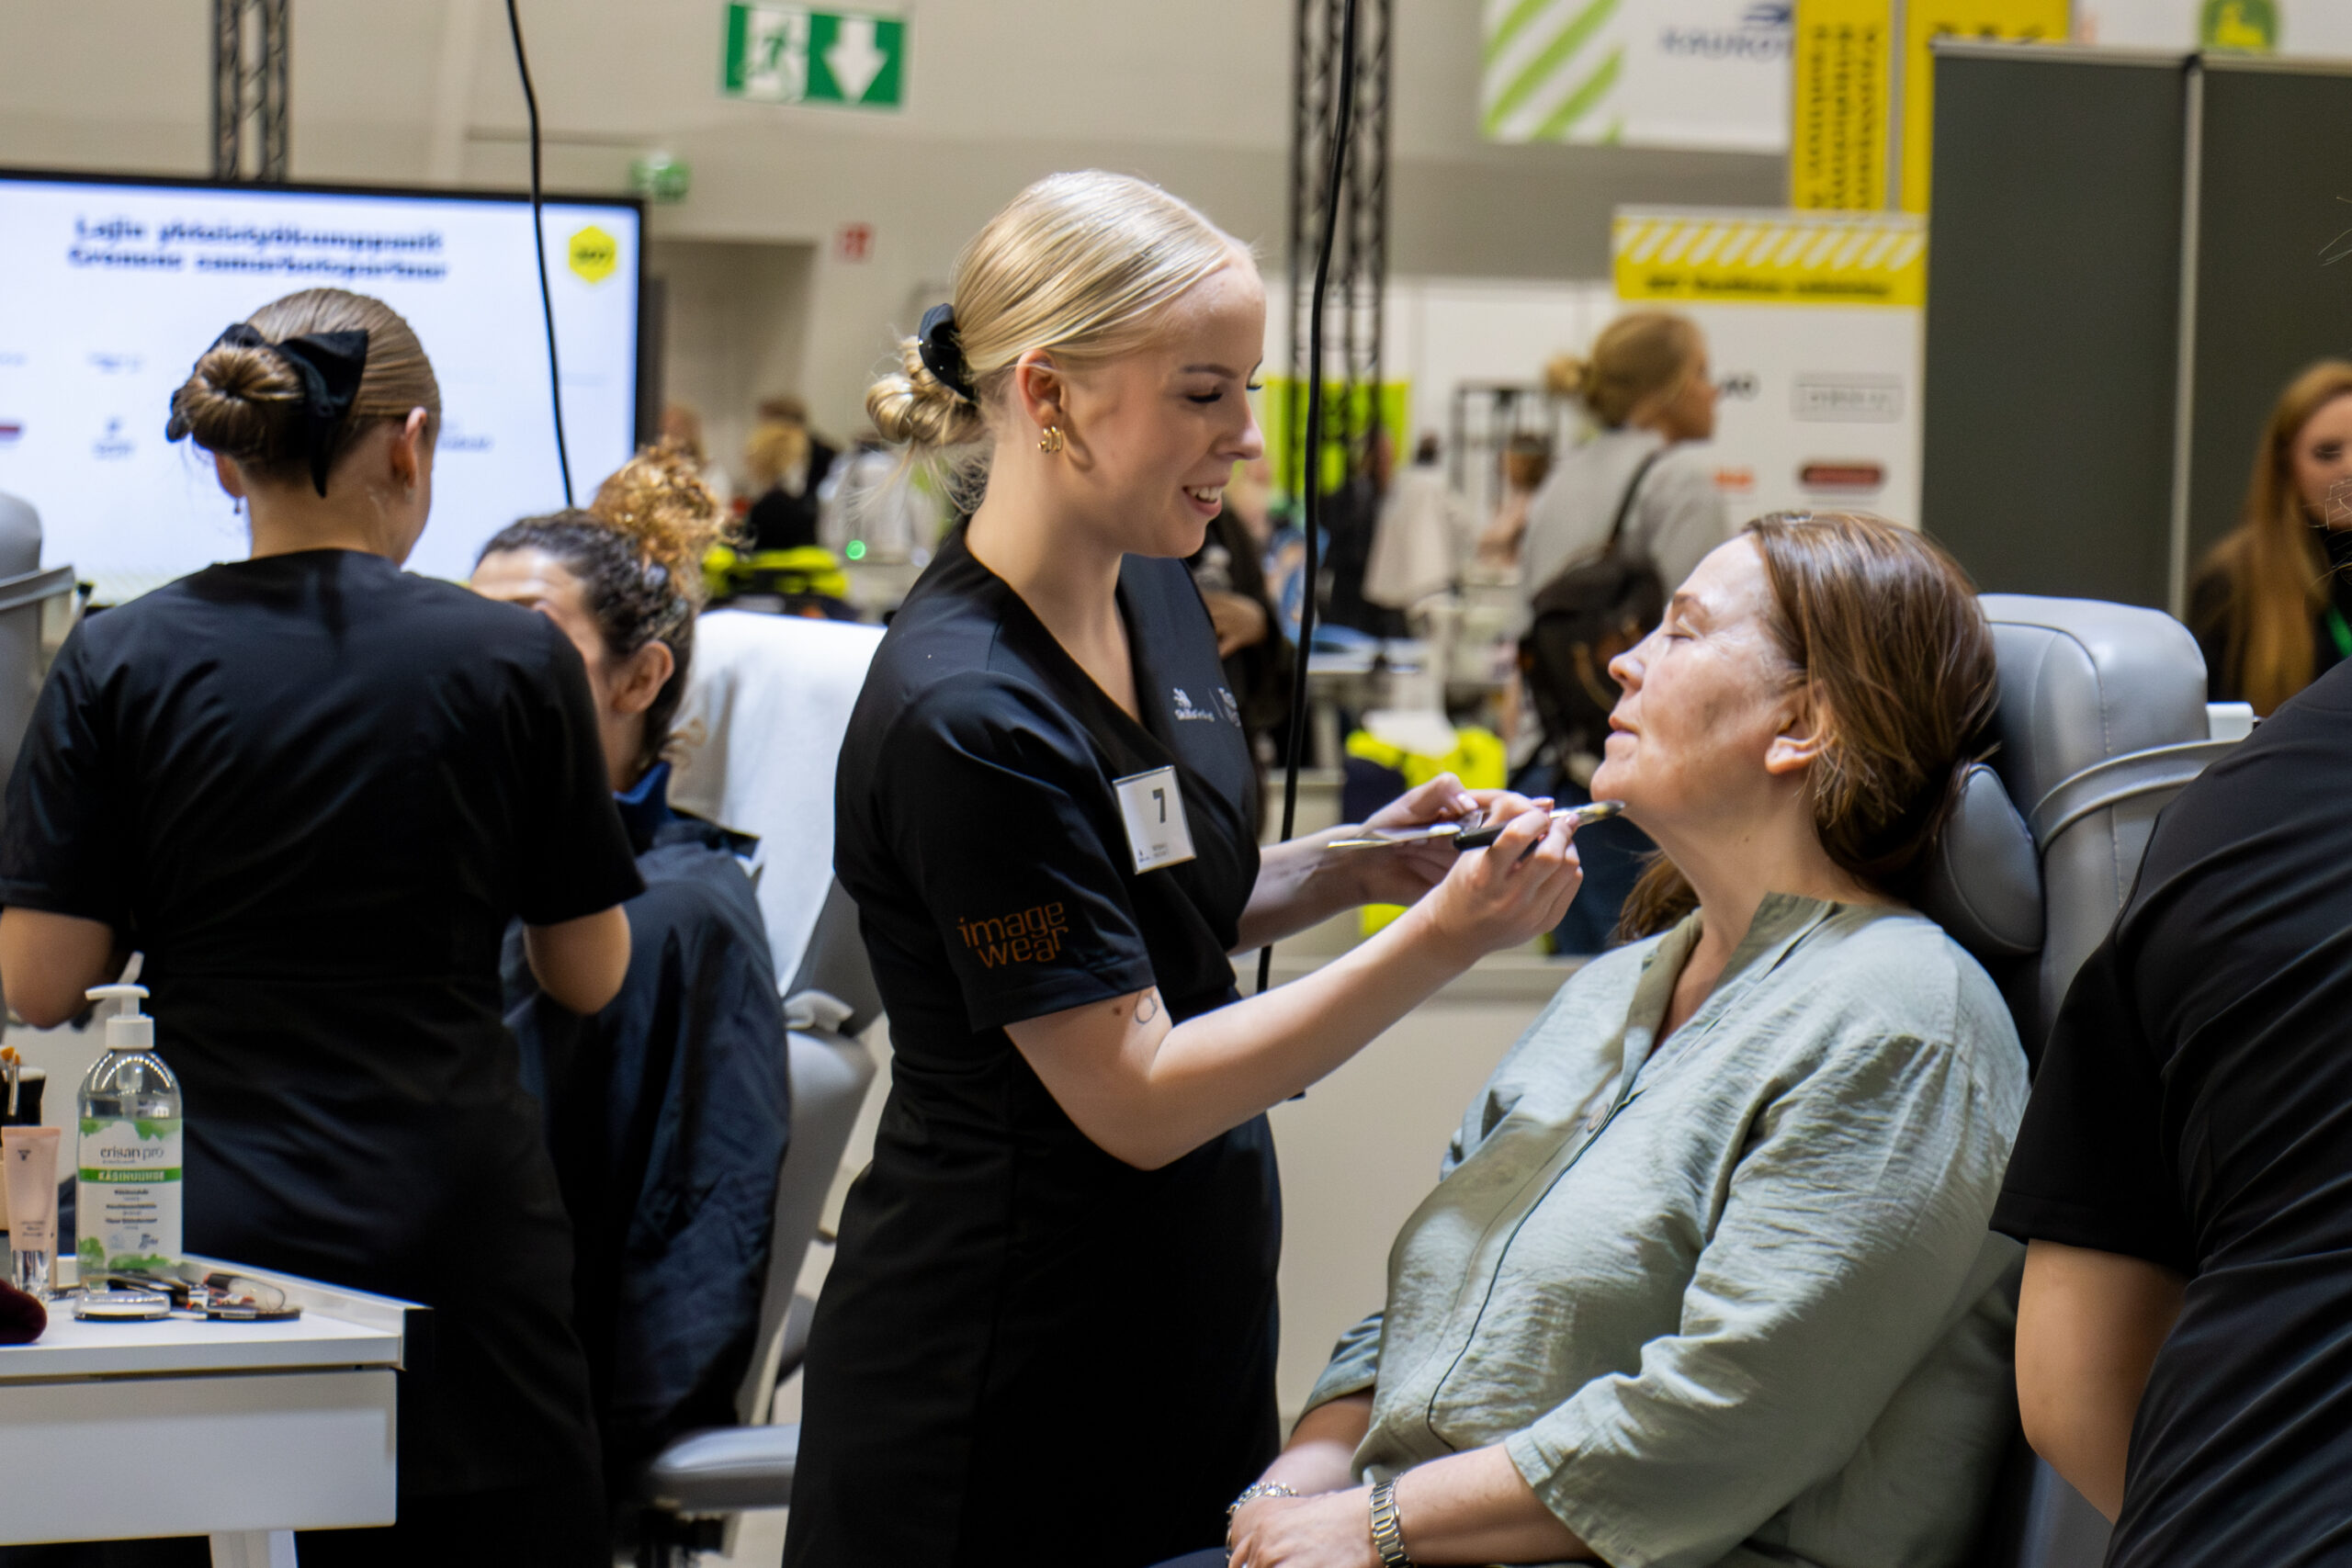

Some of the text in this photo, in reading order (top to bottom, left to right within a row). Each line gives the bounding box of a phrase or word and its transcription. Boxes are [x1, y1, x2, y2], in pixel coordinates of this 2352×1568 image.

[1152, 787, 1167, 824] 7
[956, 902, 1066, 948] image
[977, 926, 1069, 969] wear
[100, 1145, 164, 1161] erisan pro
